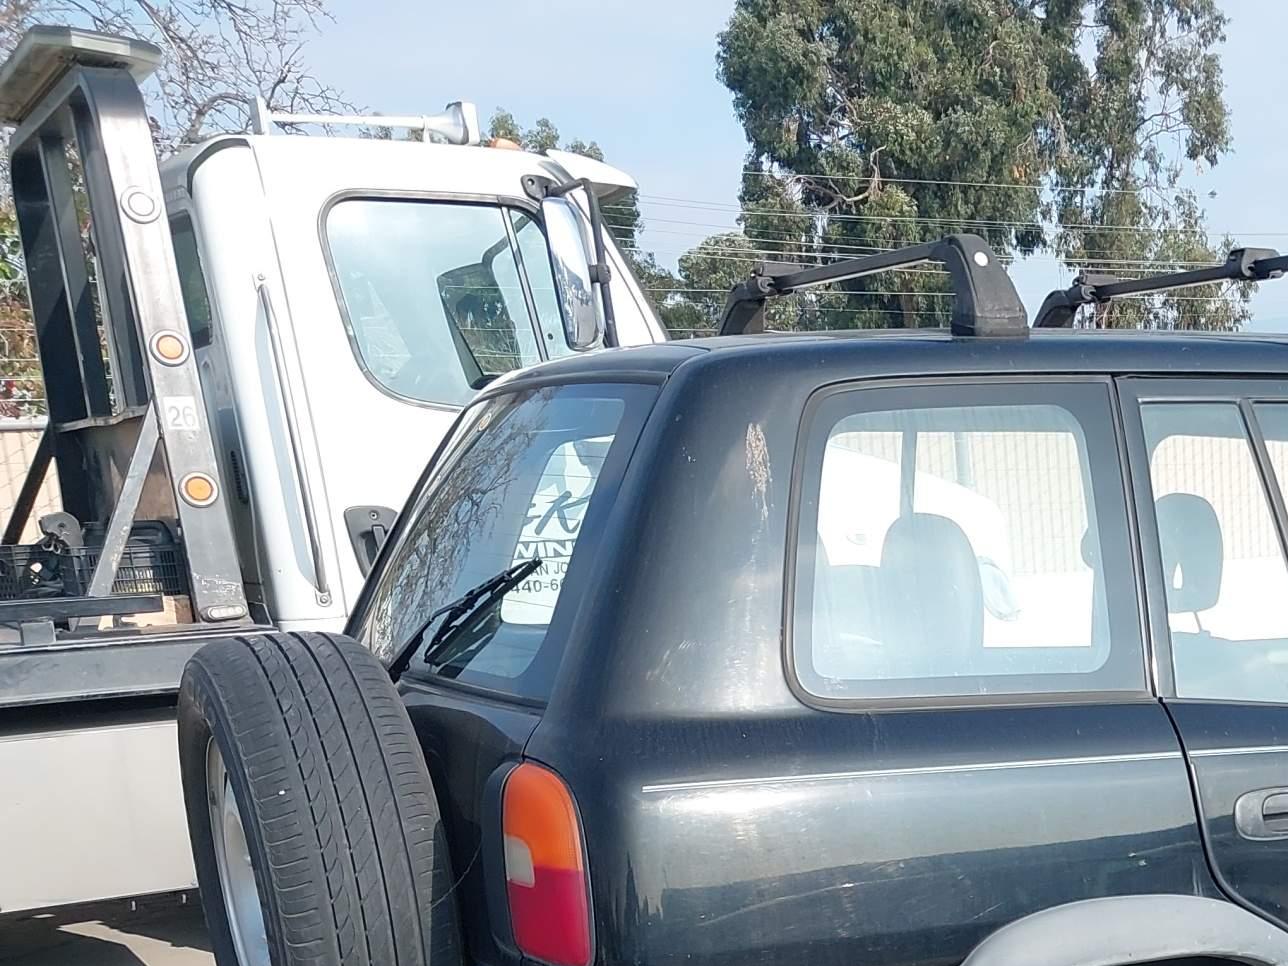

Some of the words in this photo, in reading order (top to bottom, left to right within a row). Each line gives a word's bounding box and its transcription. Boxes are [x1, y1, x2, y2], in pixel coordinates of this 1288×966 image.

[168, 405, 196, 428] 26
[514, 541, 576, 559] WIN
[529, 562, 550, 577] AN
[511, 578, 563, 594] 440-6
